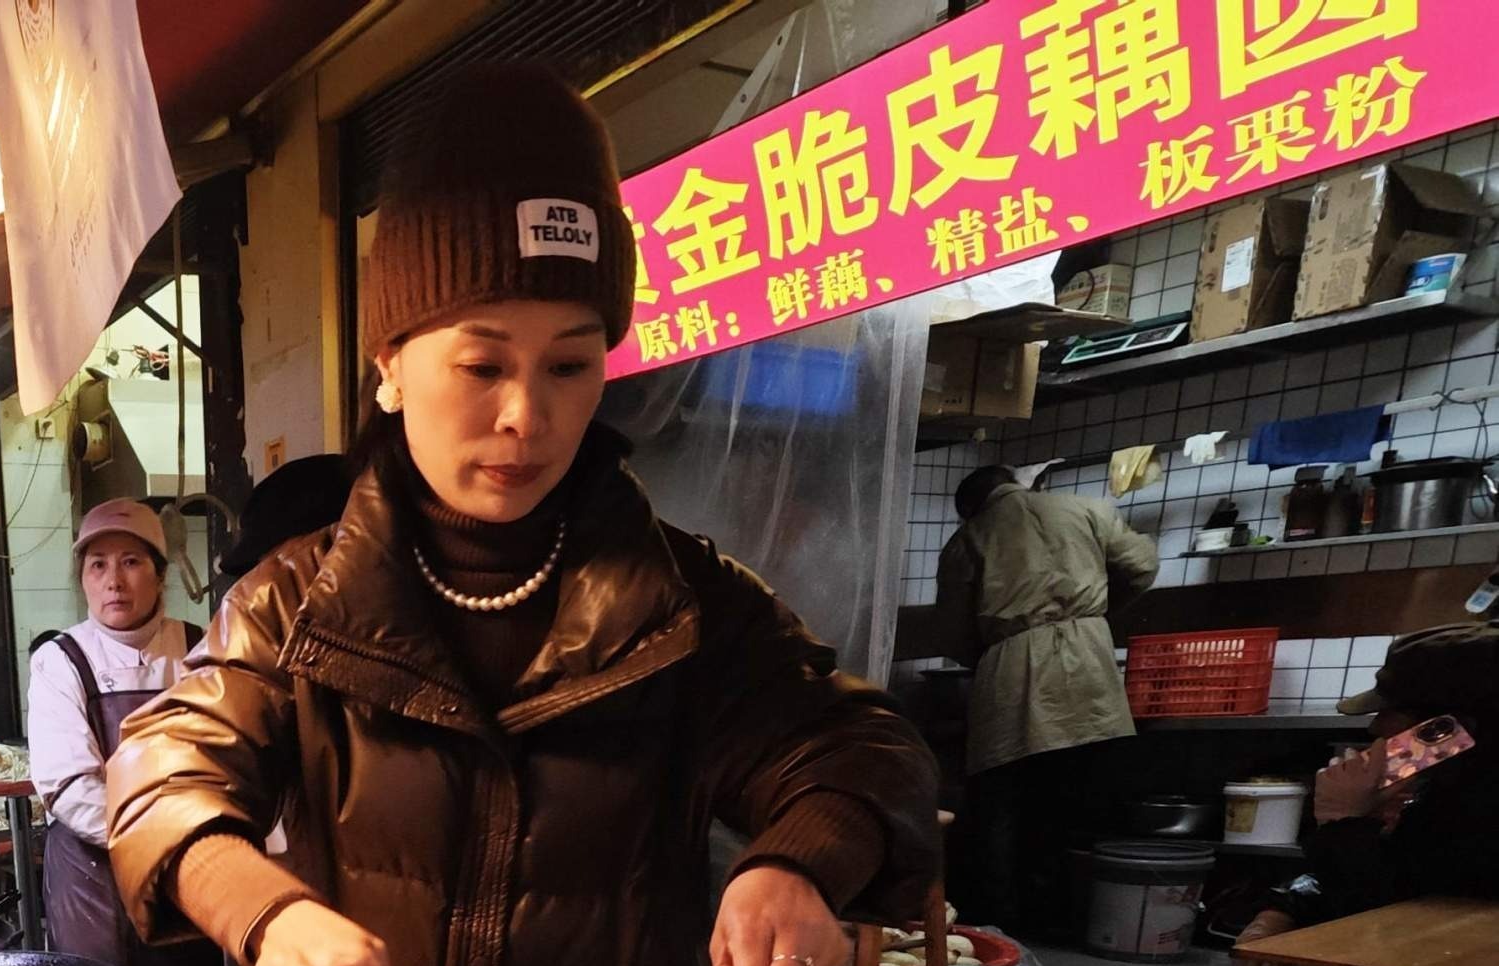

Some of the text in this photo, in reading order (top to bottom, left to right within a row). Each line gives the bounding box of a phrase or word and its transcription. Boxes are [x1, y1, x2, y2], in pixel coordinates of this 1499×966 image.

[623, 0, 1418, 304] 金脆皮藕
[545, 205, 579, 224] ATB
[530, 224, 593, 247] TELOLY
